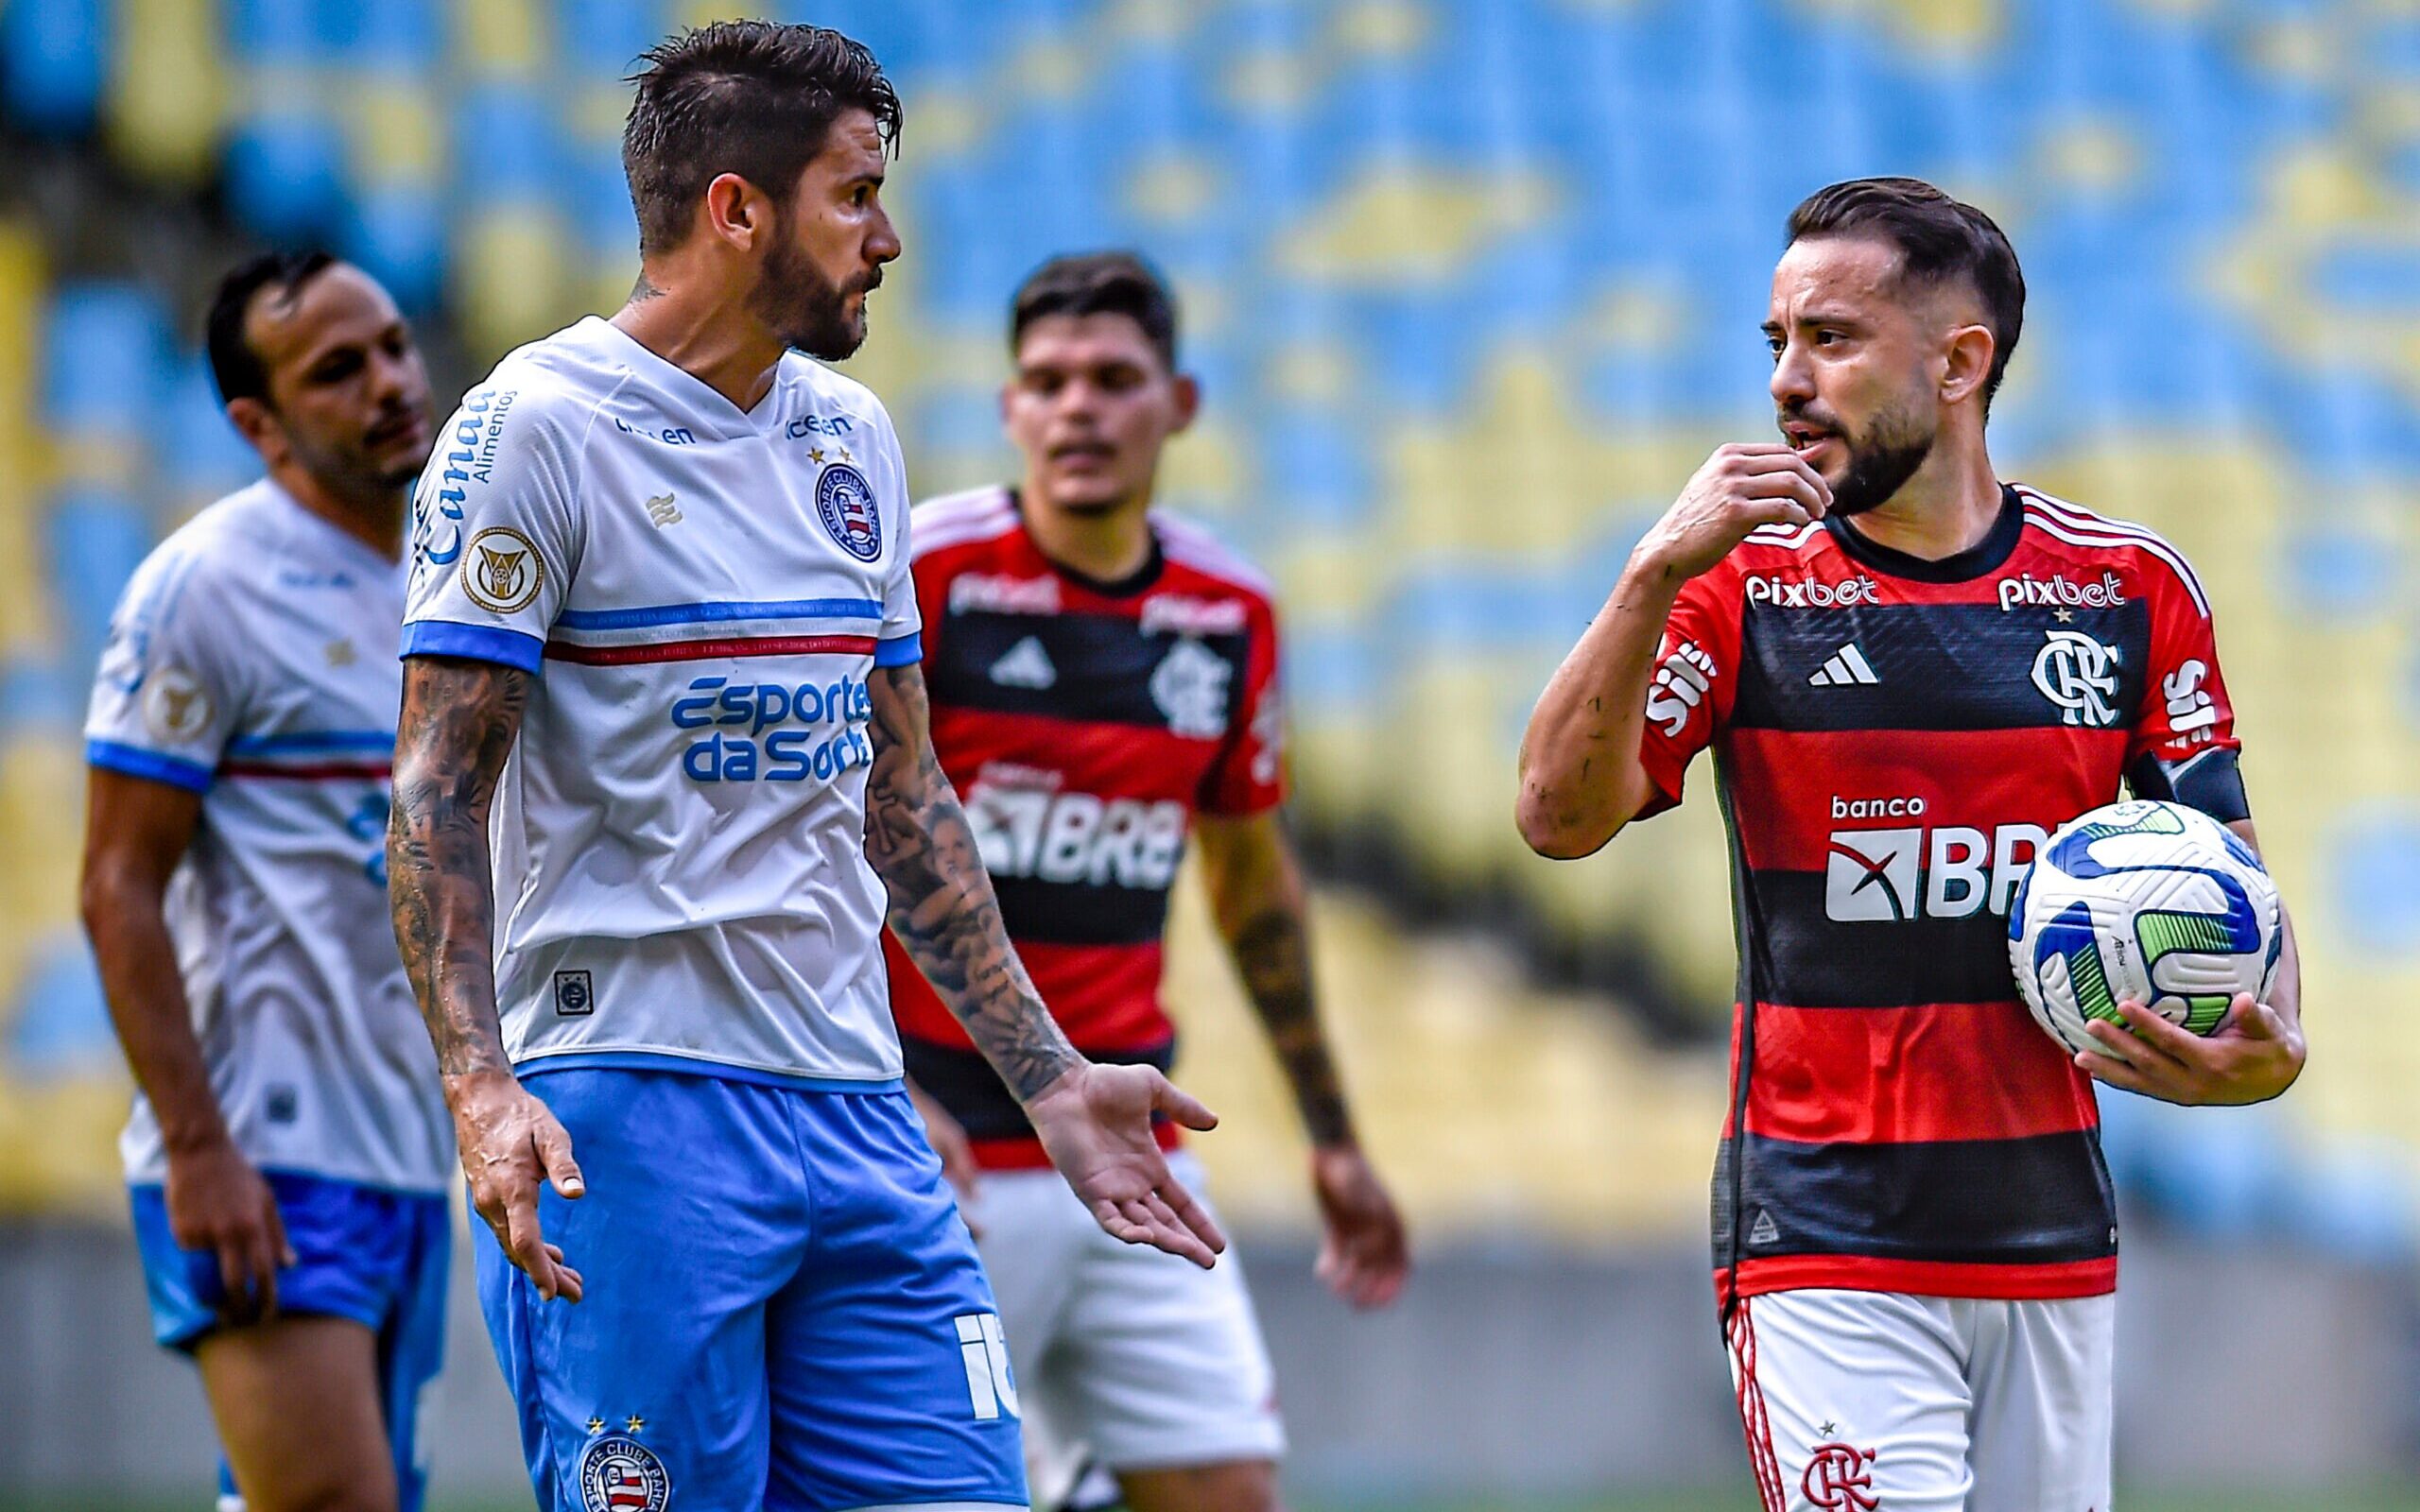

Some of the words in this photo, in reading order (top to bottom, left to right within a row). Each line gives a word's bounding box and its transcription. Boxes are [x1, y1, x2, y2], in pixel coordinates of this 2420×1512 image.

[473, 390, 518, 484] Alimentos
[1997, 572, 2126, 612] pixbet
[683, 731, 755, 782] da
[1831, 795, 1926, 819] banco
[1925, 822, 2066, 919] BR
[583, 1450, 606, 1512] ESPORTE
[606, 1441, 653, 1468] CLUBE
[648, 1467, 665, 1512] BAHIA
